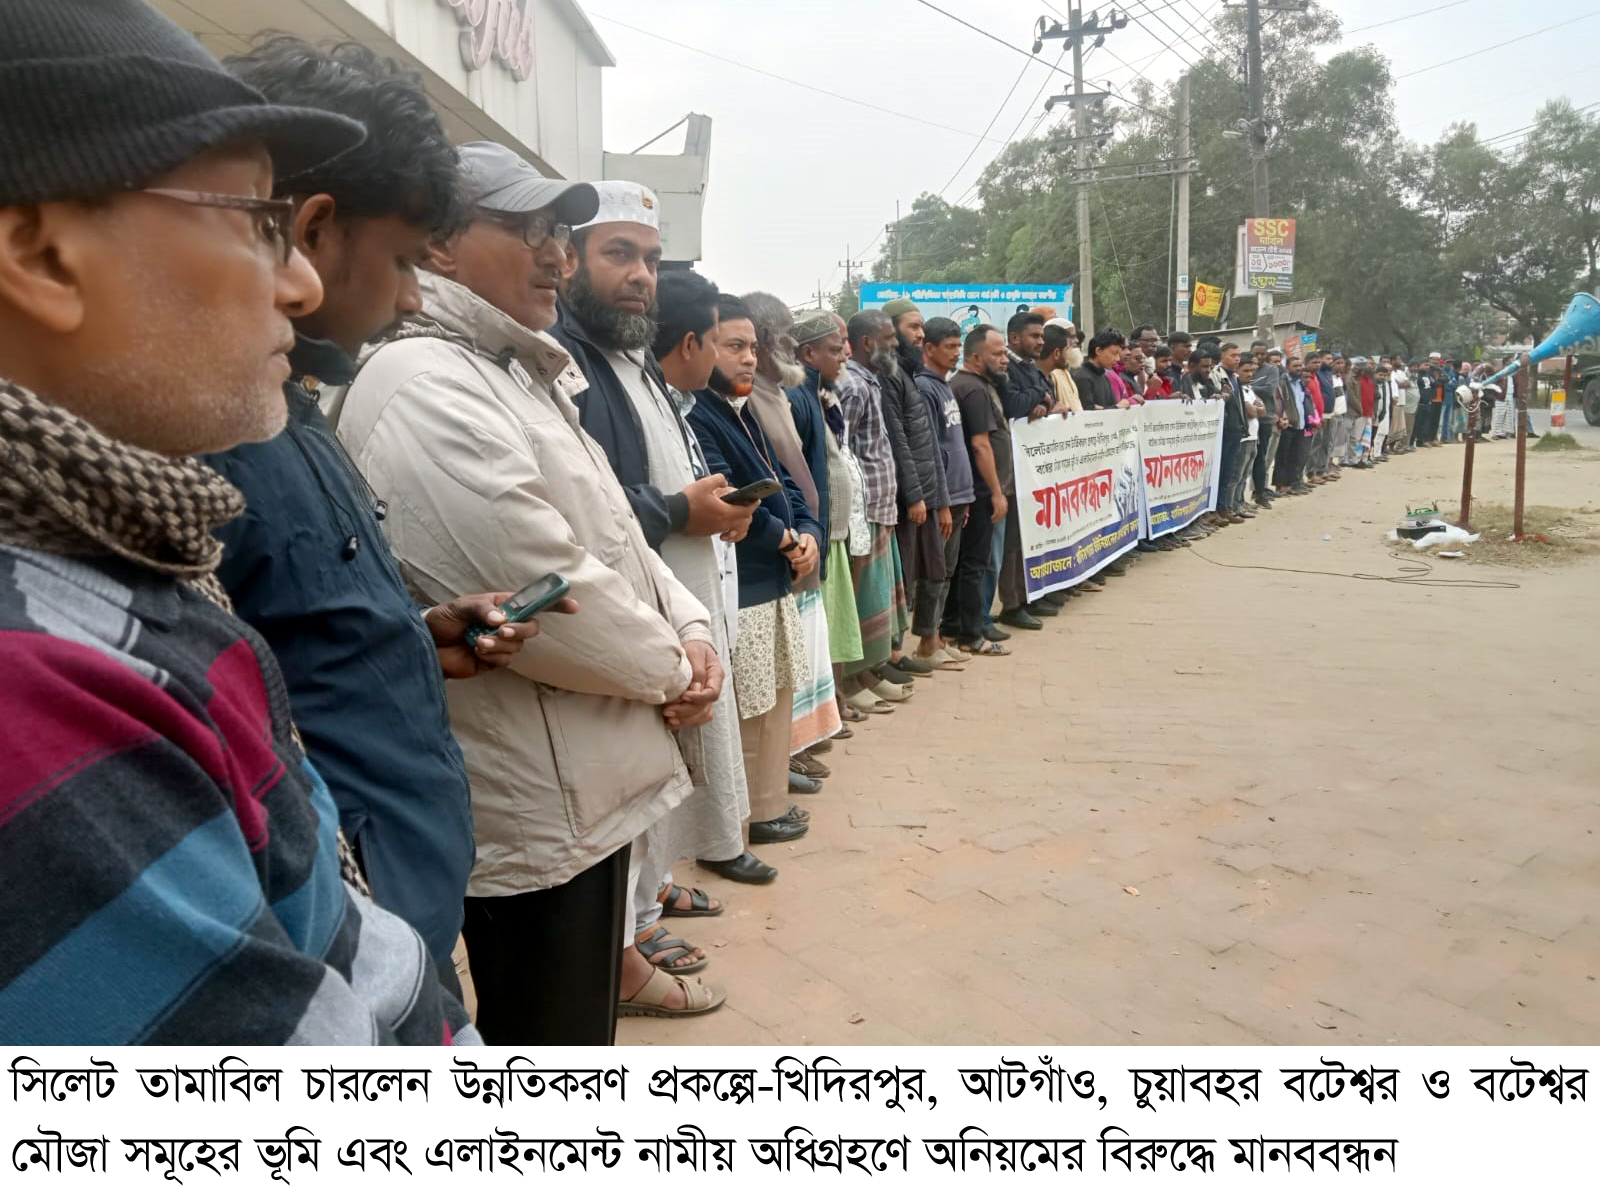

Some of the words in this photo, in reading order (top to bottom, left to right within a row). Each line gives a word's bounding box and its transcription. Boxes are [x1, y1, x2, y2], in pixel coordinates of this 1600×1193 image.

[1254, 218, 1289, 237] SSC
[1144, 450, 1205, 489] মানববন্ধন
[1032, 468, 1113, 530] মানববন্ধন
